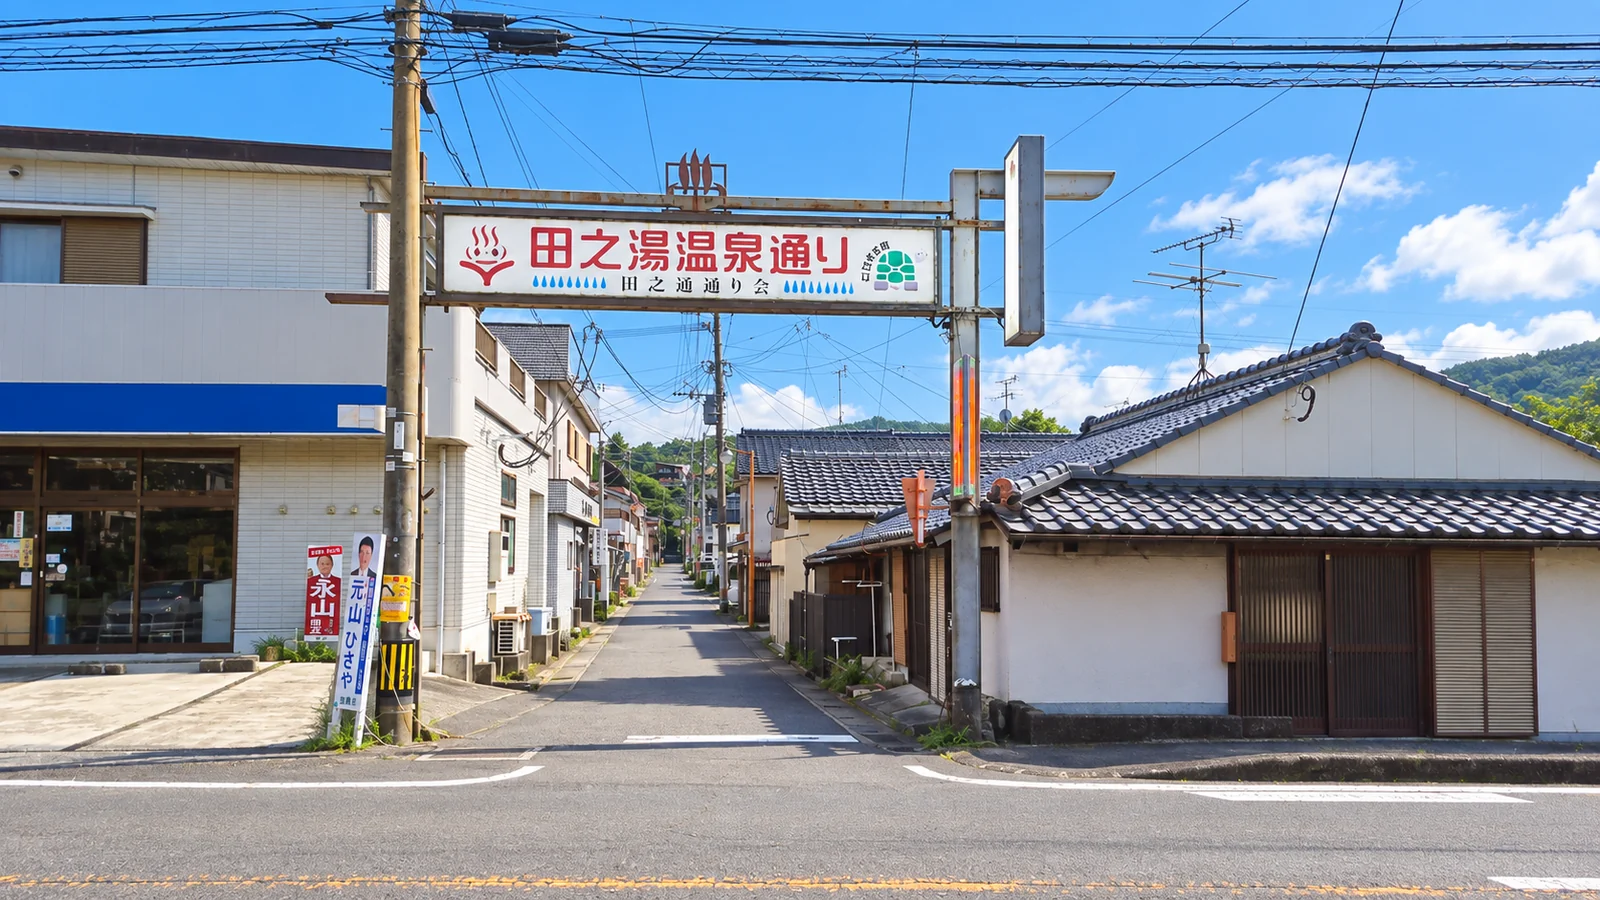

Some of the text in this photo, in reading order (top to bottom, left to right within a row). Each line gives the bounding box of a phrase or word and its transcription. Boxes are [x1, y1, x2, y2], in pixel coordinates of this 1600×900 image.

[530, 227, 849, 274] 田之湯温泉通り
[621, 275, 769, 295] 田之通通り会
